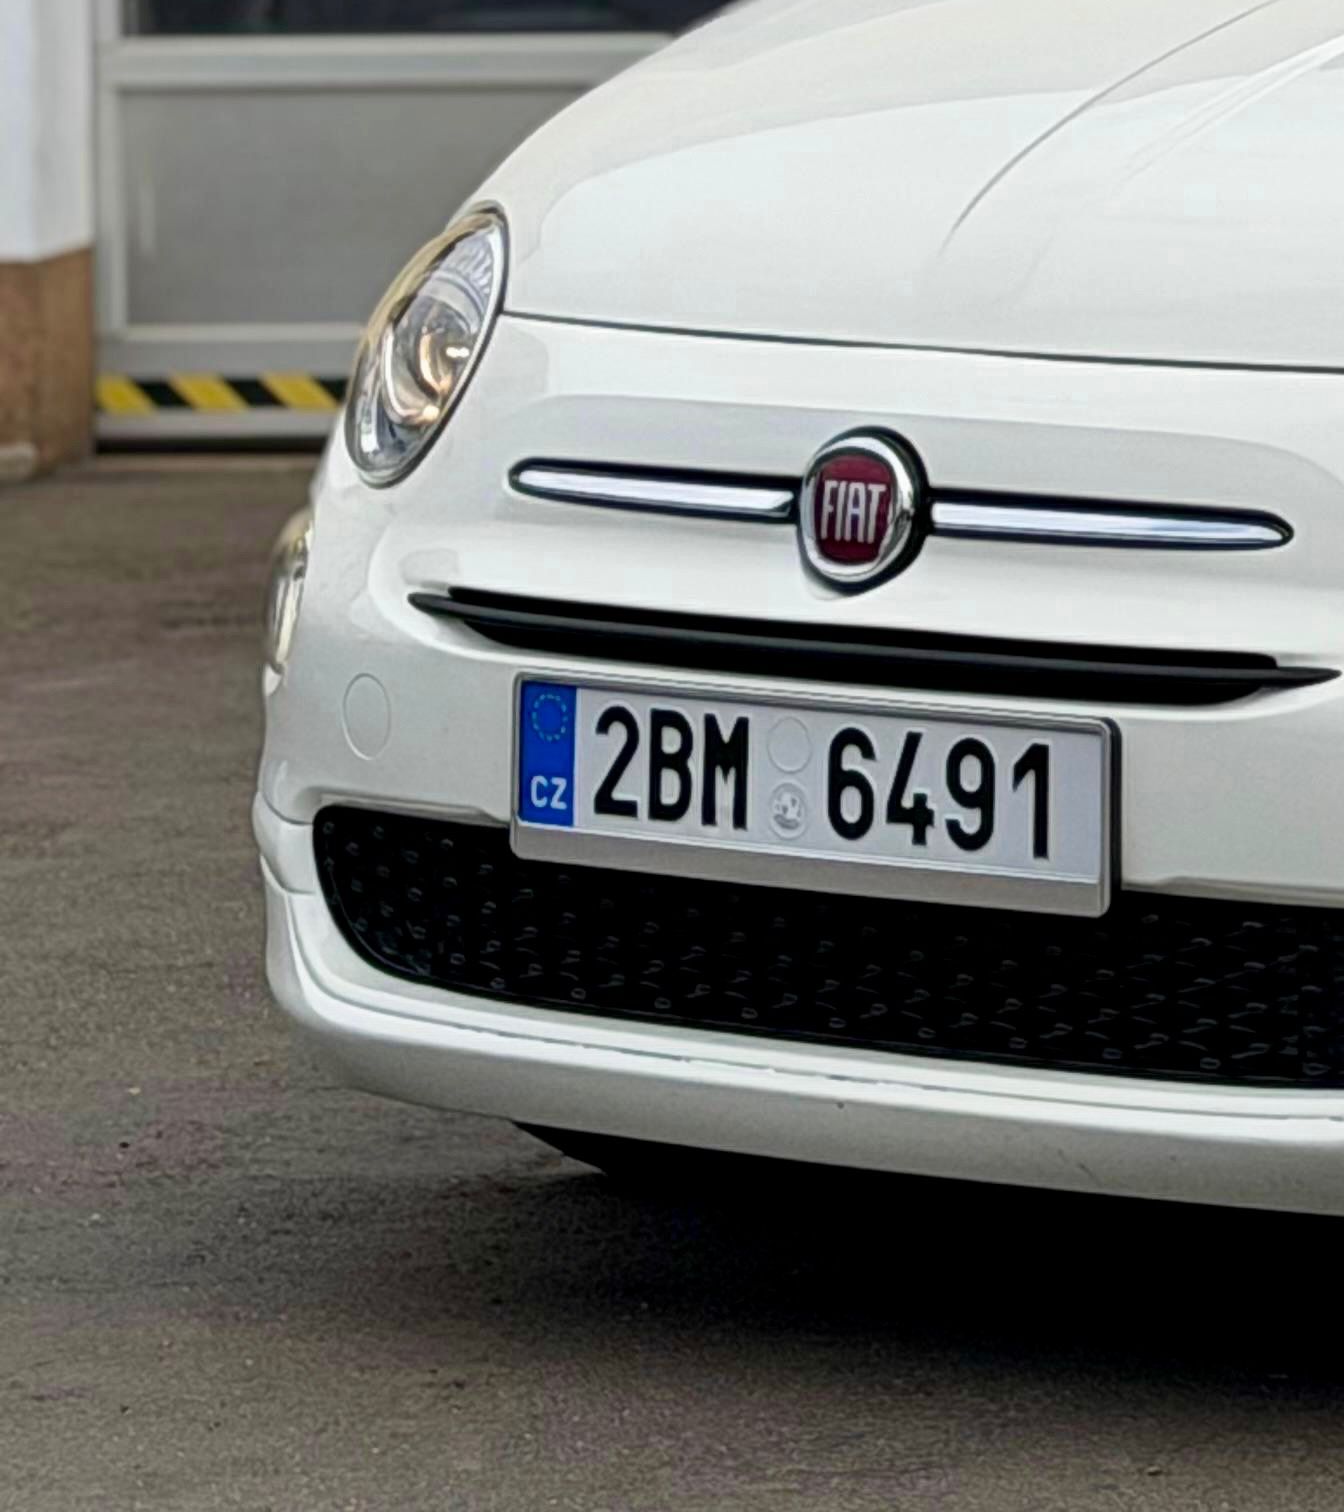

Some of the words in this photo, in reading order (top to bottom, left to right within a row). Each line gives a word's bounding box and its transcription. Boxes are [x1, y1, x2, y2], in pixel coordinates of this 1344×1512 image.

[820, 480, 888, 544] FIAT
[529, 775, 568, 812] CZ
[593, 705, 750, 830] 2BM
[827, 726, 1050, 860] 6491
